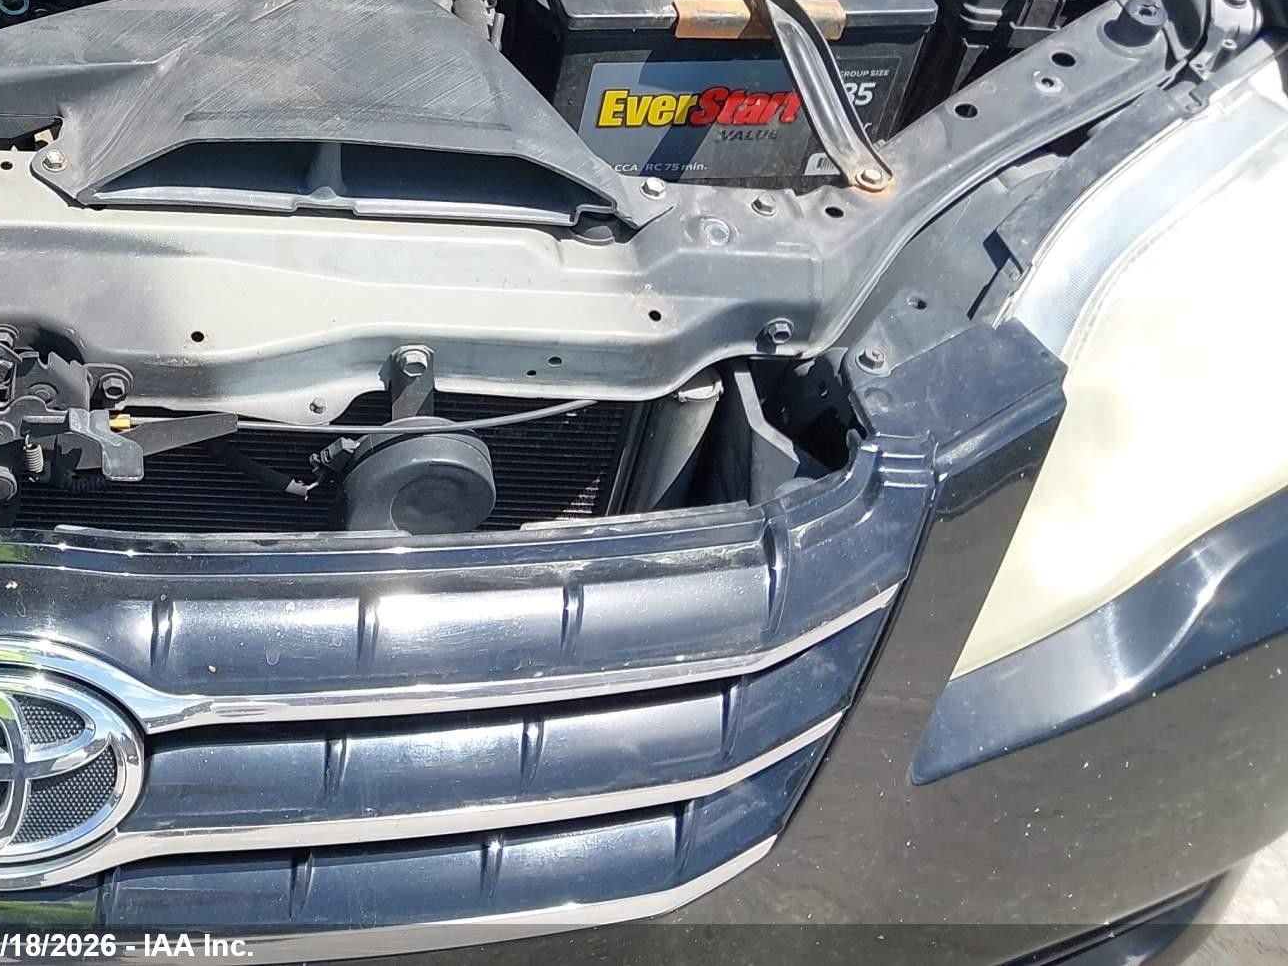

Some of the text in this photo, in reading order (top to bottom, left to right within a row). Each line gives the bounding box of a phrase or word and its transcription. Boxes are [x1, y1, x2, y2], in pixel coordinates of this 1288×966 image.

[870, 69, 890, 77] SIZE
[596, 85, 802, 128] EverStart
[718, 129, 778, 143] VALUE
[614, 162, 708, 172] CCA RC 75 min.
